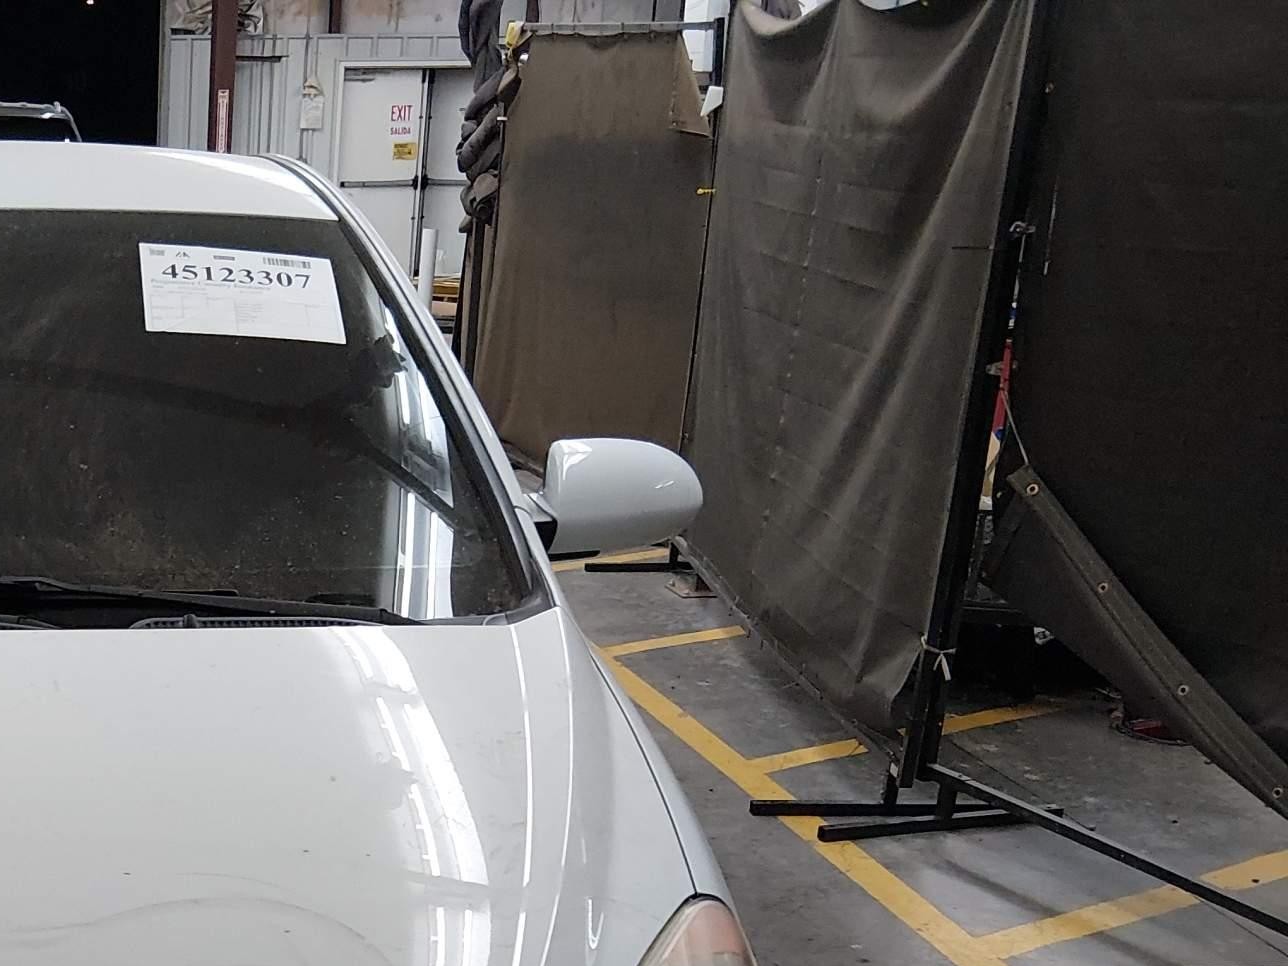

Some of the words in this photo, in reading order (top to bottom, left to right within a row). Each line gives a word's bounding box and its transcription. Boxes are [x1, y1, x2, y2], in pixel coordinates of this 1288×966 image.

[391, 104, 413, 121] EXIT
[390, 127, 411, 135] SALIDA
[161, 263, 312, 289] 45123307
